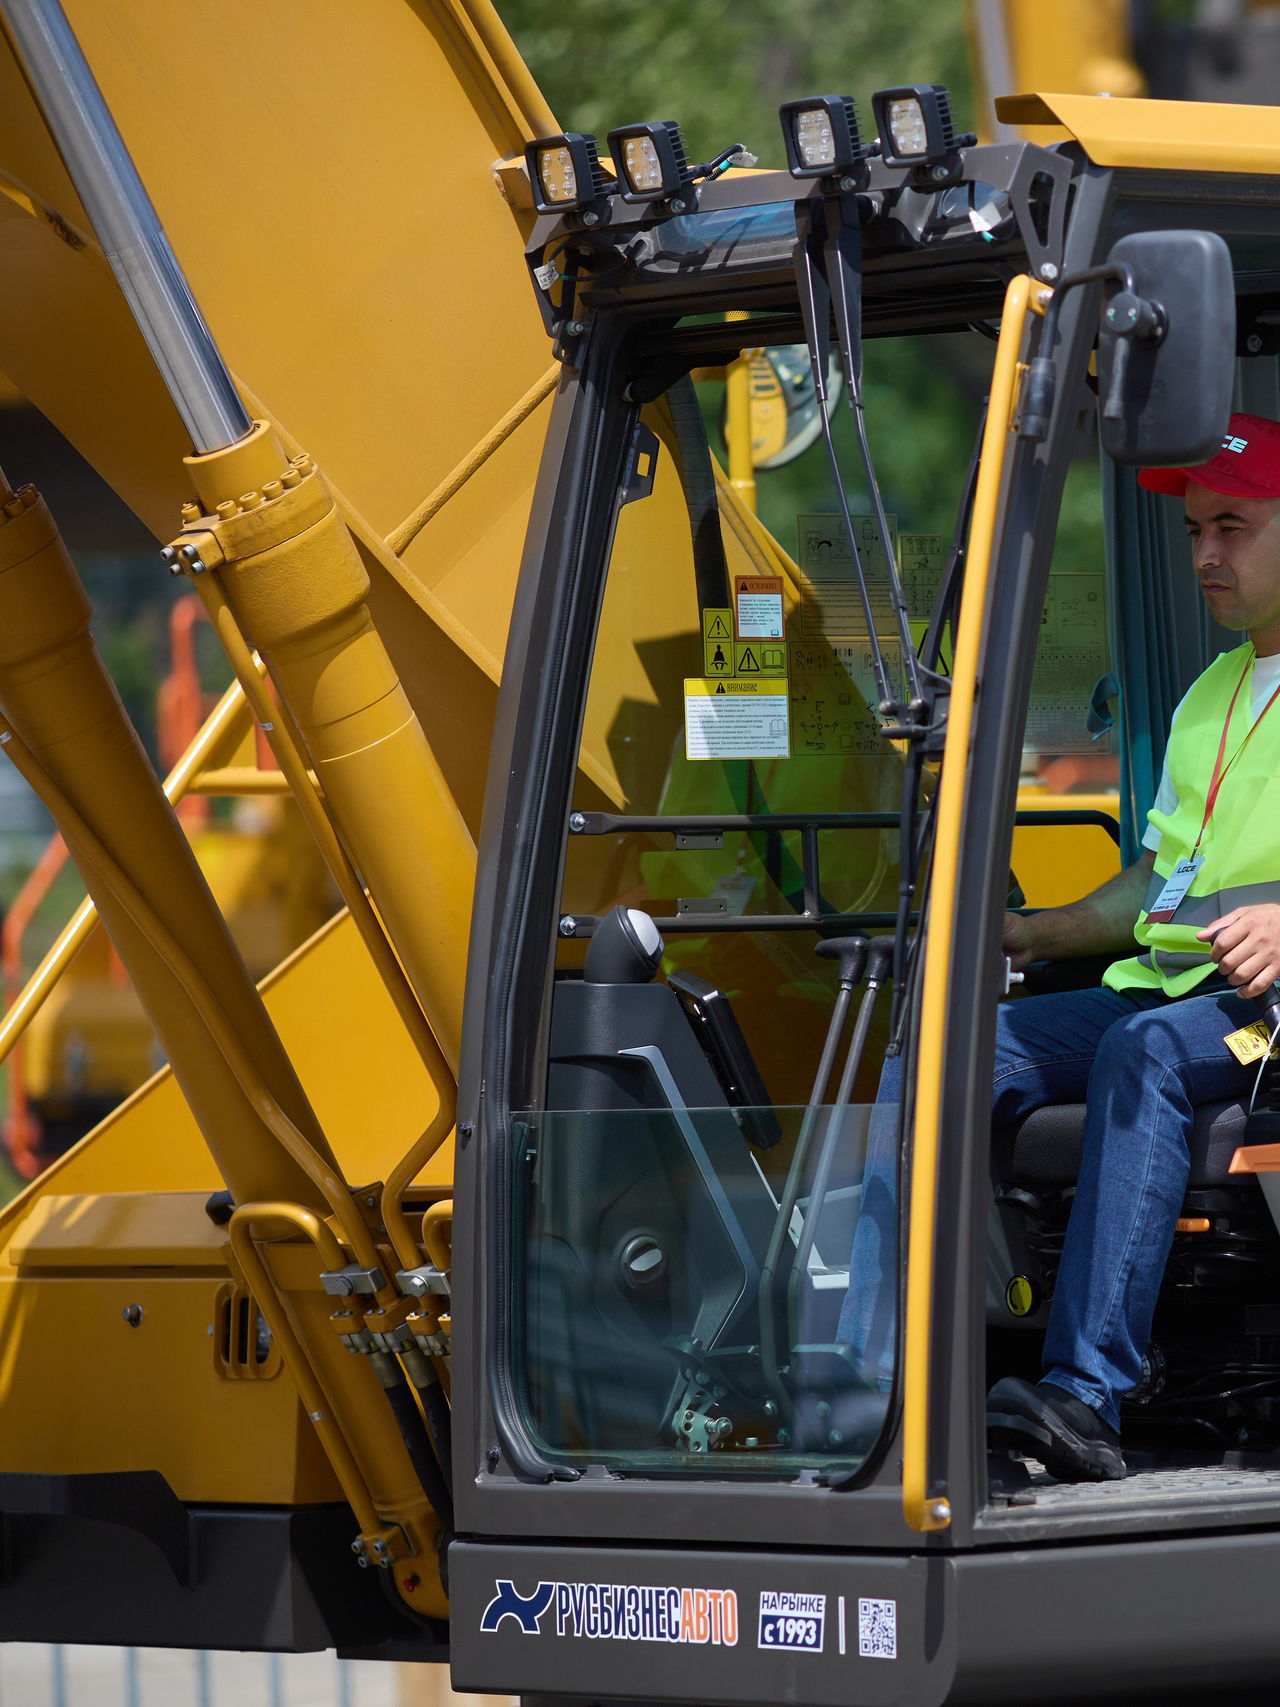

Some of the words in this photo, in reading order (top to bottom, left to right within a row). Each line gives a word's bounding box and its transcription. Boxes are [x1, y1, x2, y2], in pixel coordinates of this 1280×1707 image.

[1221, 434, 1248, 454] CE
[781, 1595, 824, 1613] РЫНКЕ
[557, 1584, 738, 1645] РУСБИЗНЕСАВТО
